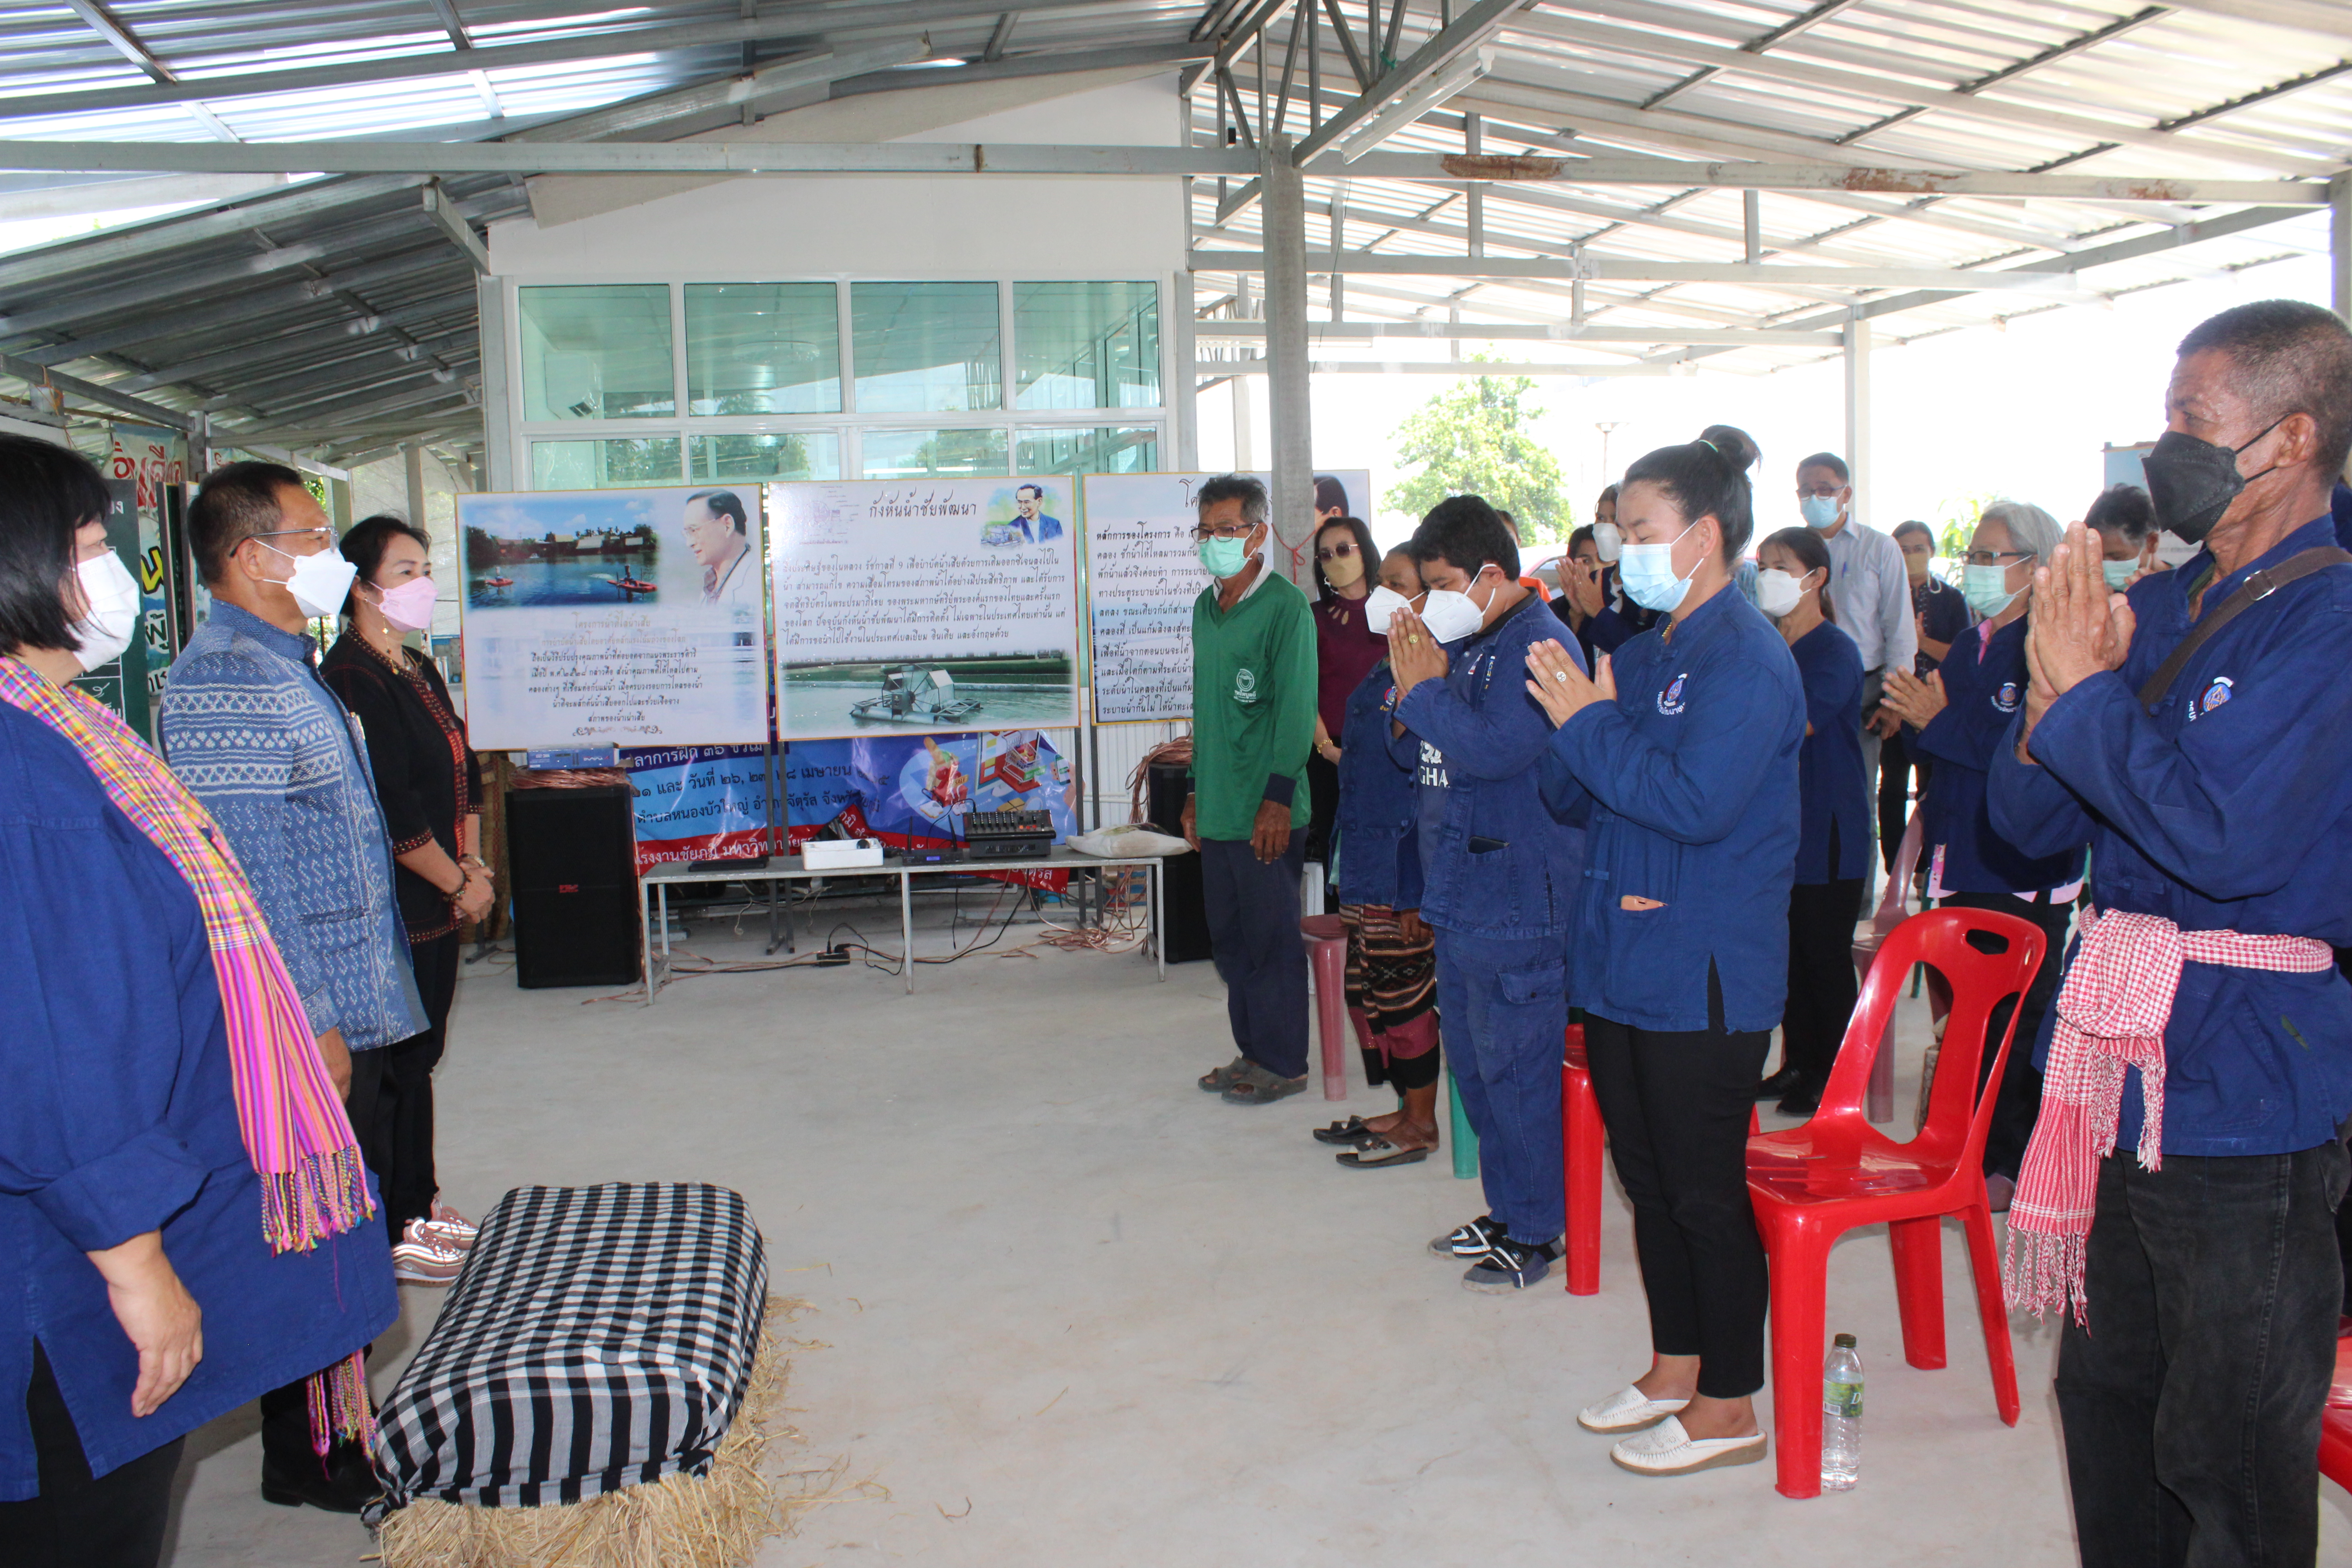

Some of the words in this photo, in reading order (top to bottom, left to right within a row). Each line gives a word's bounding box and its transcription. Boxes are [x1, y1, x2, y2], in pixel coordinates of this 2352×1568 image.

[869, 486, 976, 518] กังหันน้ำชัยพัฒนา
[1096, 521, 1171, 541] หลักการของโครงการ
[1173, 526, 1184, 538] คือ
[1121, 540, 1199, 559] ชักน้ำให้ไหลมารวมกัน
[866, 555, 895, 570] รัชกาลที่
[1098, 560, 1167, 578] พักน้ำแล้วจึงค่อยทำ
[1171, 568, 1210, 577] การระบาย
[784, 575, 792, 590] น้ำ
[797, 572, 842, 590] สามารถแก้ไข
[1021, 566, 1065, 583] และได้รับการ
[785, 610, 812, 627] ของโลก
[948, 602, 1052, 621] ไม่เฉพาะในประเทศไทยเท่านั้น
[1056, 607, 1066, 617] แต่
[931, 628, 954, 640] อินเดีย
[957, 623, 1009, 641] และอังกฤษด้วย
[1100, 620, 1126, 635] คลองที่
[1129, 619, 1192, 638] เป็นแก้มลิงลงสู่ทะ
[1101, 637, 1192, 657] เพื่อที่น้ำจากตอนบนจะได้
[532, 665, 548, 677] เมื่อปี
[589, 665, 613, 676] กล่าวคือ
[529, 683, 560, 693] คลองต่างๆ
[1102, 676, 1193, 695] ระดับน้ำในคลองที่เป็นแก้ม
[1103, 695, 1155, 714] ระบายน้ำกั้นไม่
[1156, 693, 1194, 711] ให้น้ำทะเล
[628, 746, 698, 767] ลาการฝึก
[657, 781, 683, 794] และ
[689, 767, 715, 789] วันที่
[802, 765, 852, 778] เมษายน
[637, 797, 749, 824] ตำบลหนองบัวใหญ่
